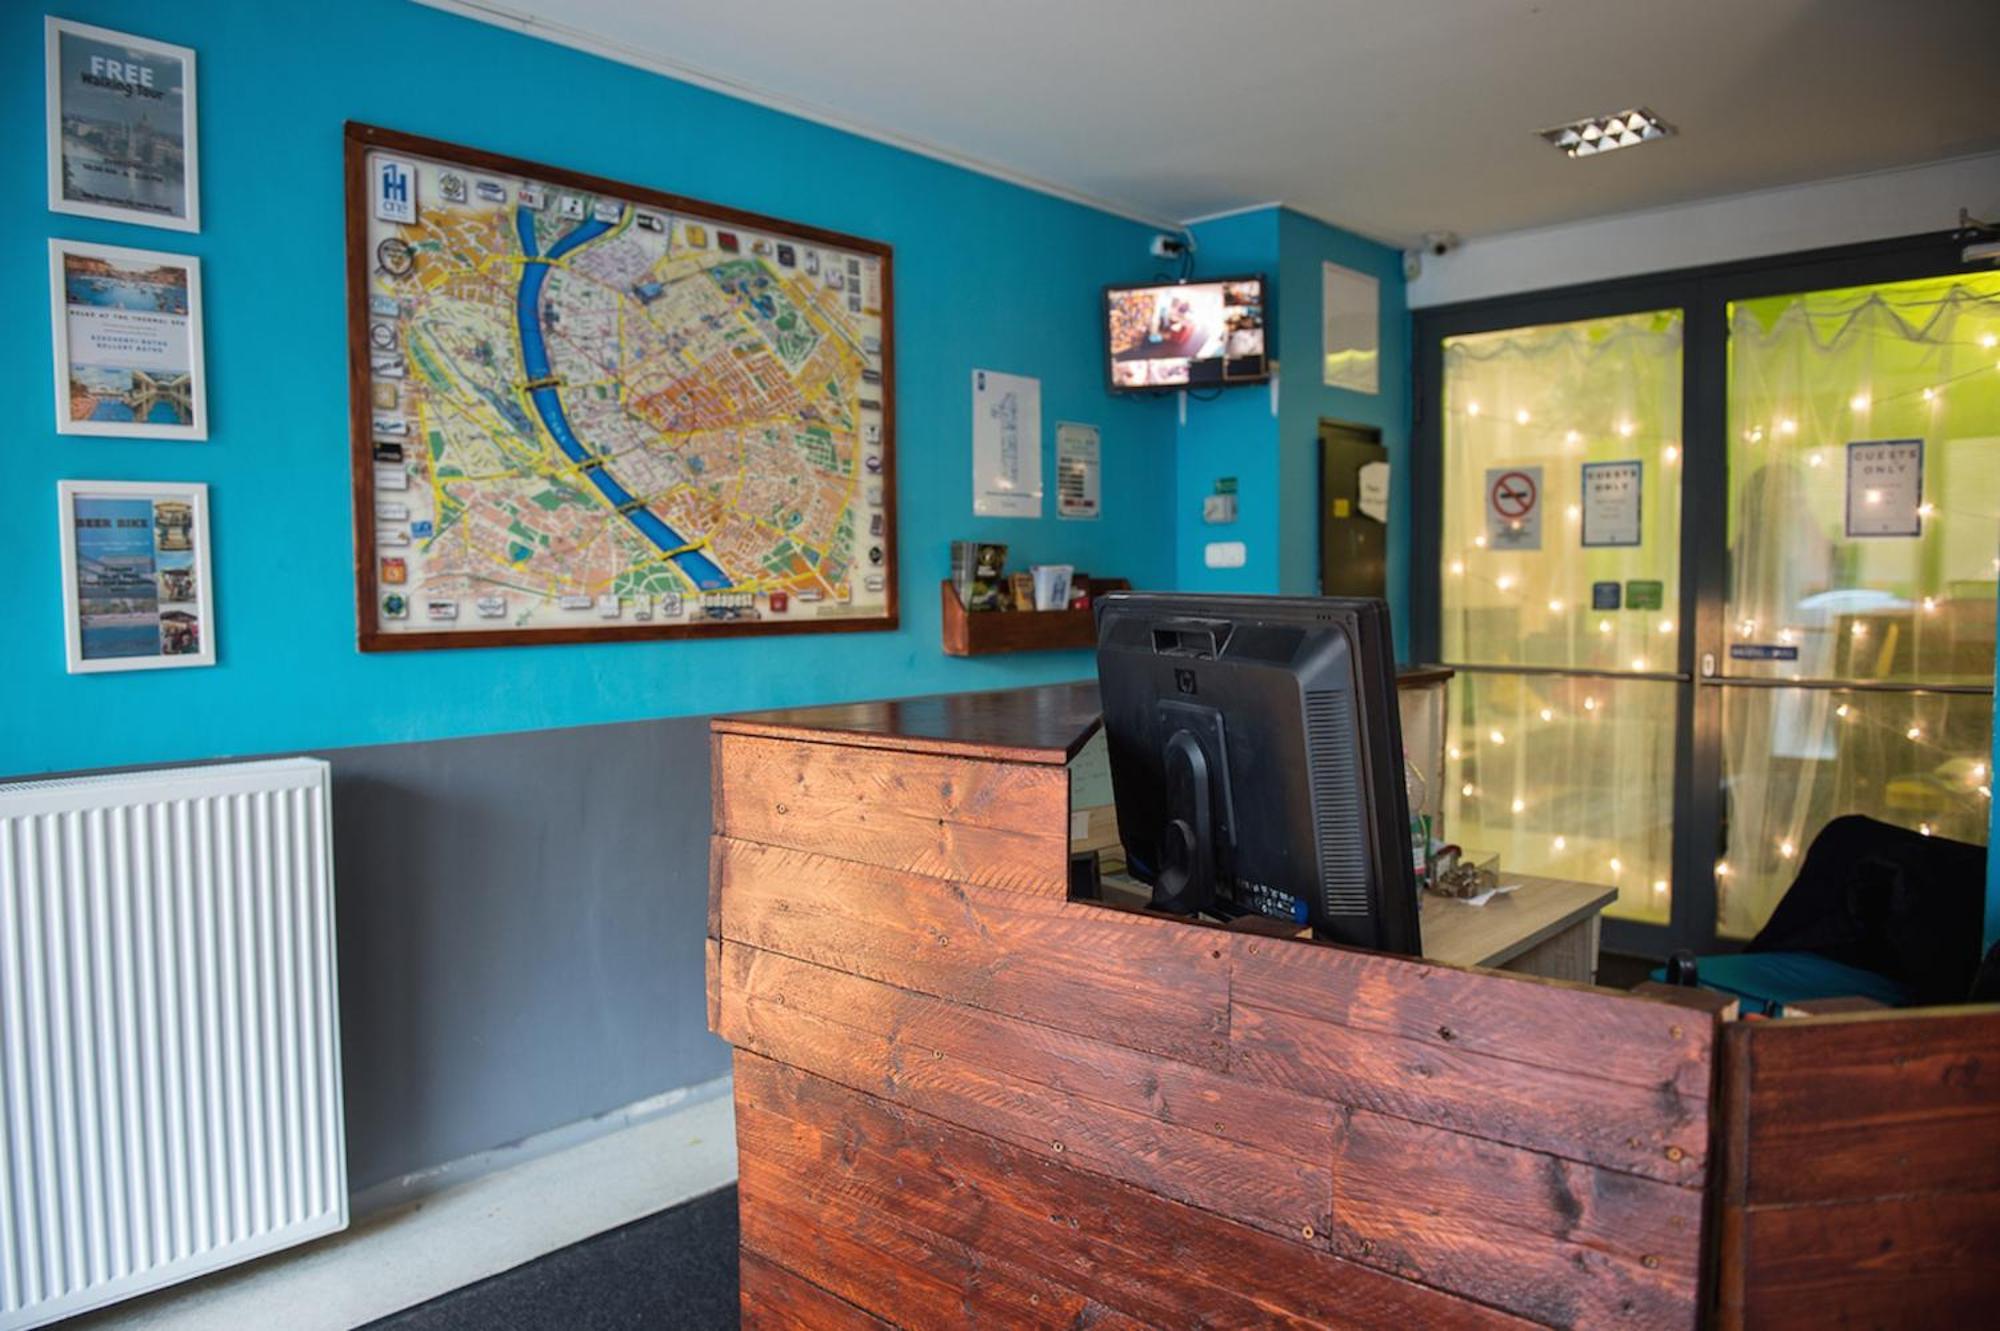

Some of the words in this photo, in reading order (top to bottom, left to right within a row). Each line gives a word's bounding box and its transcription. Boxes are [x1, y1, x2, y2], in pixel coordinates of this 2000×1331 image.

[90, 55, 154, 88] FREE
[81, 71, 133, 98] Walking
[136, 83, 165, 100] Tour
[1855, 449, 1917, 461] GUESTS
[1863, 464, 1906, 475] ONLY
